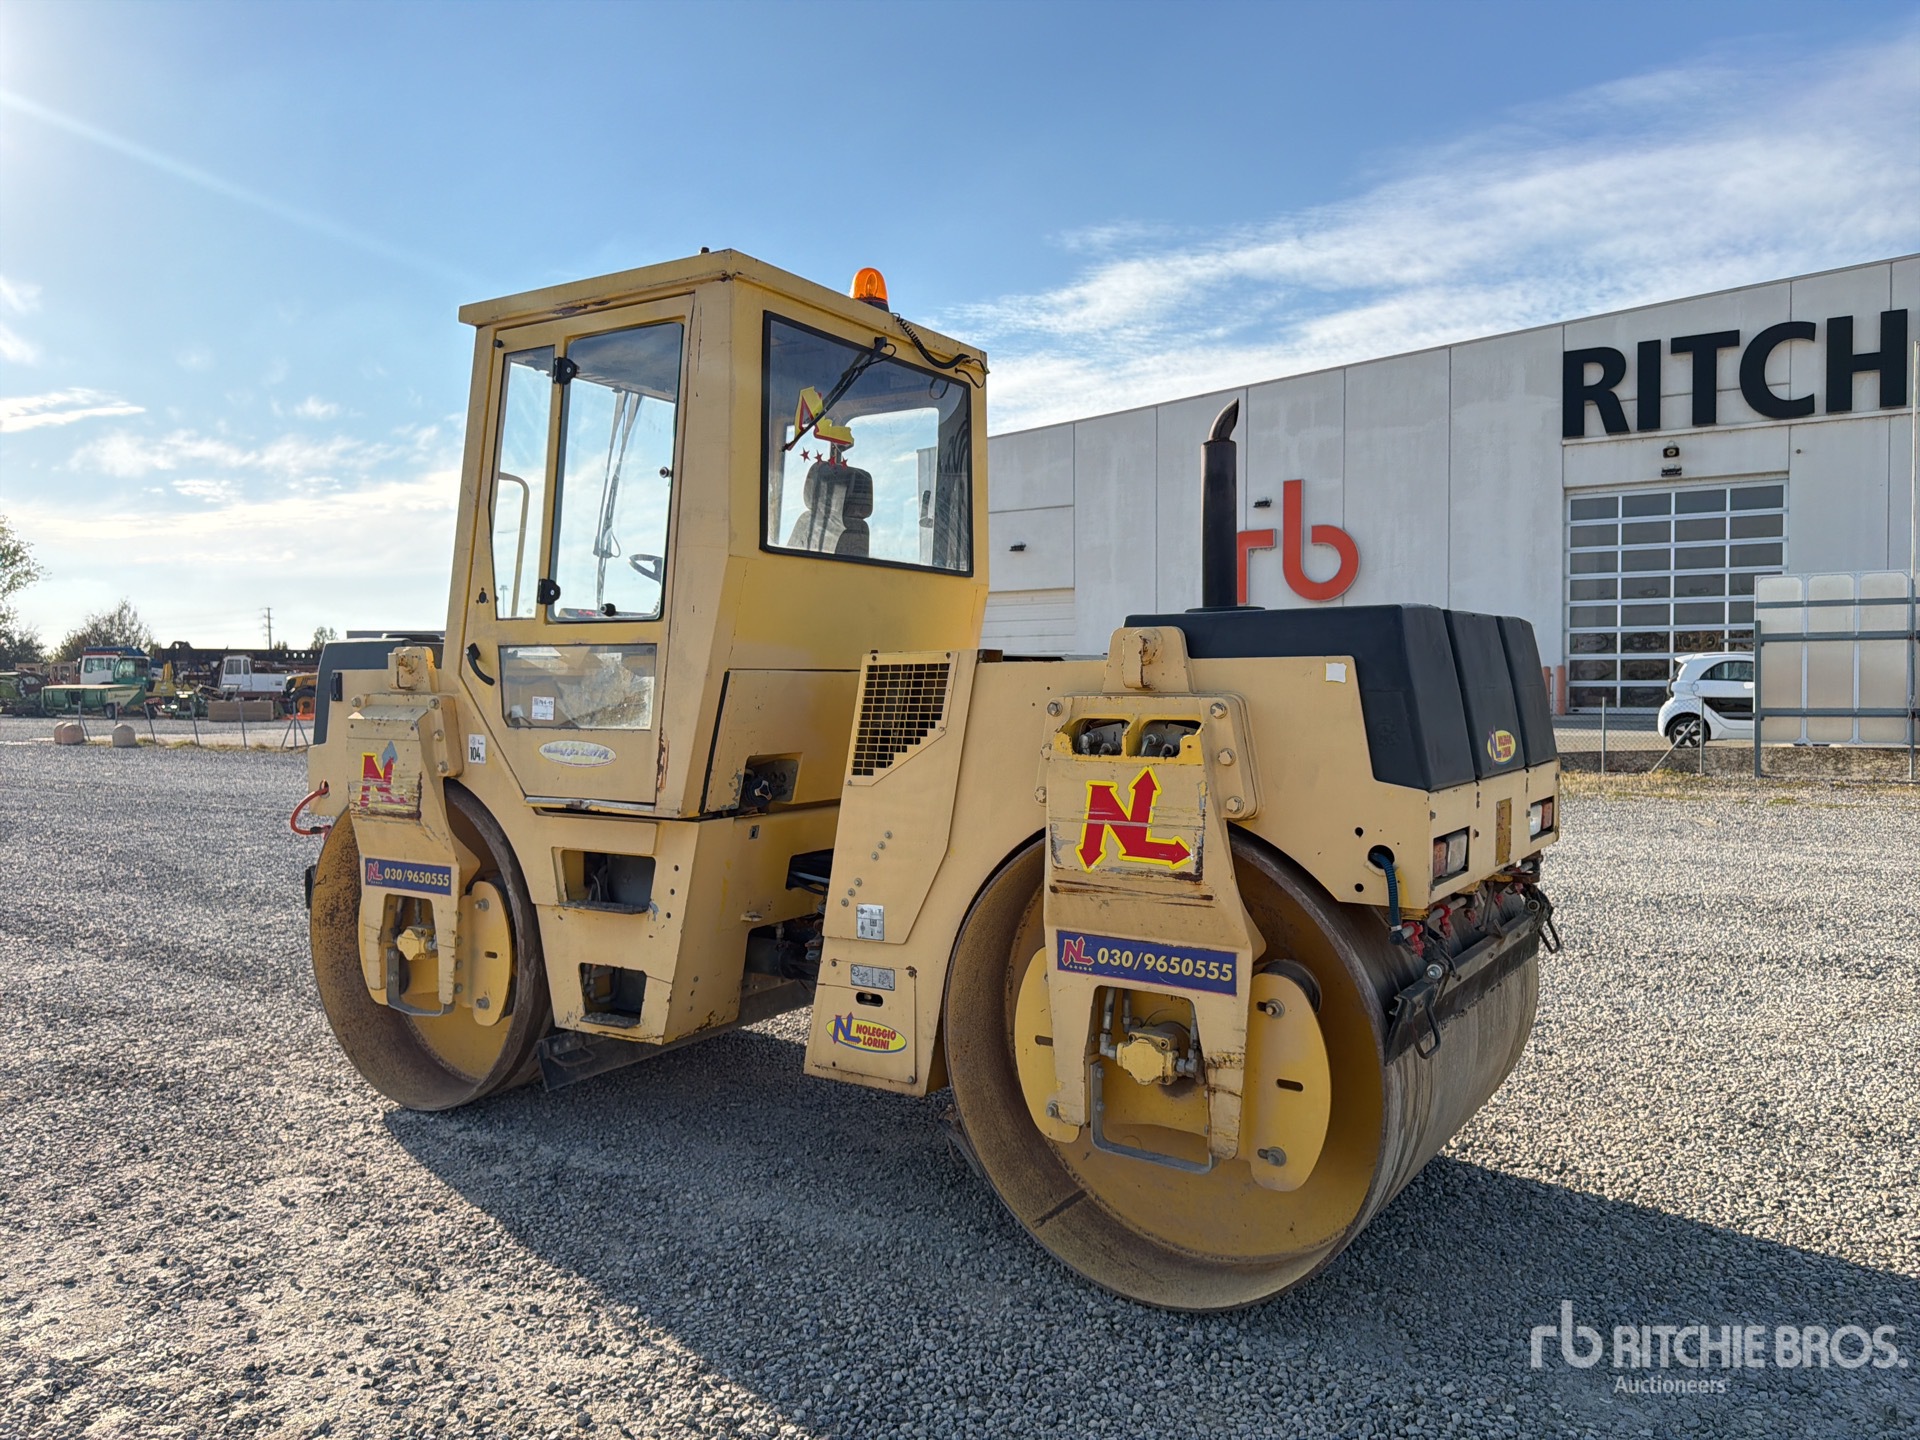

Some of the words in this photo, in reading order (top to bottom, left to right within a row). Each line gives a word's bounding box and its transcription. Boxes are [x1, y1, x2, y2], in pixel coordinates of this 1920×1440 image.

[1562, 308, 1908, 438] RITCH
[470, 746, 481, 761] 104
[384, 867, 450, 887] 030/9650555
[1097, 947, 1233, 982] 030/9650555
[856, 1024, 897, 1041] NOLEGGIO
[862, 1036, 890, 1050] LORINI
